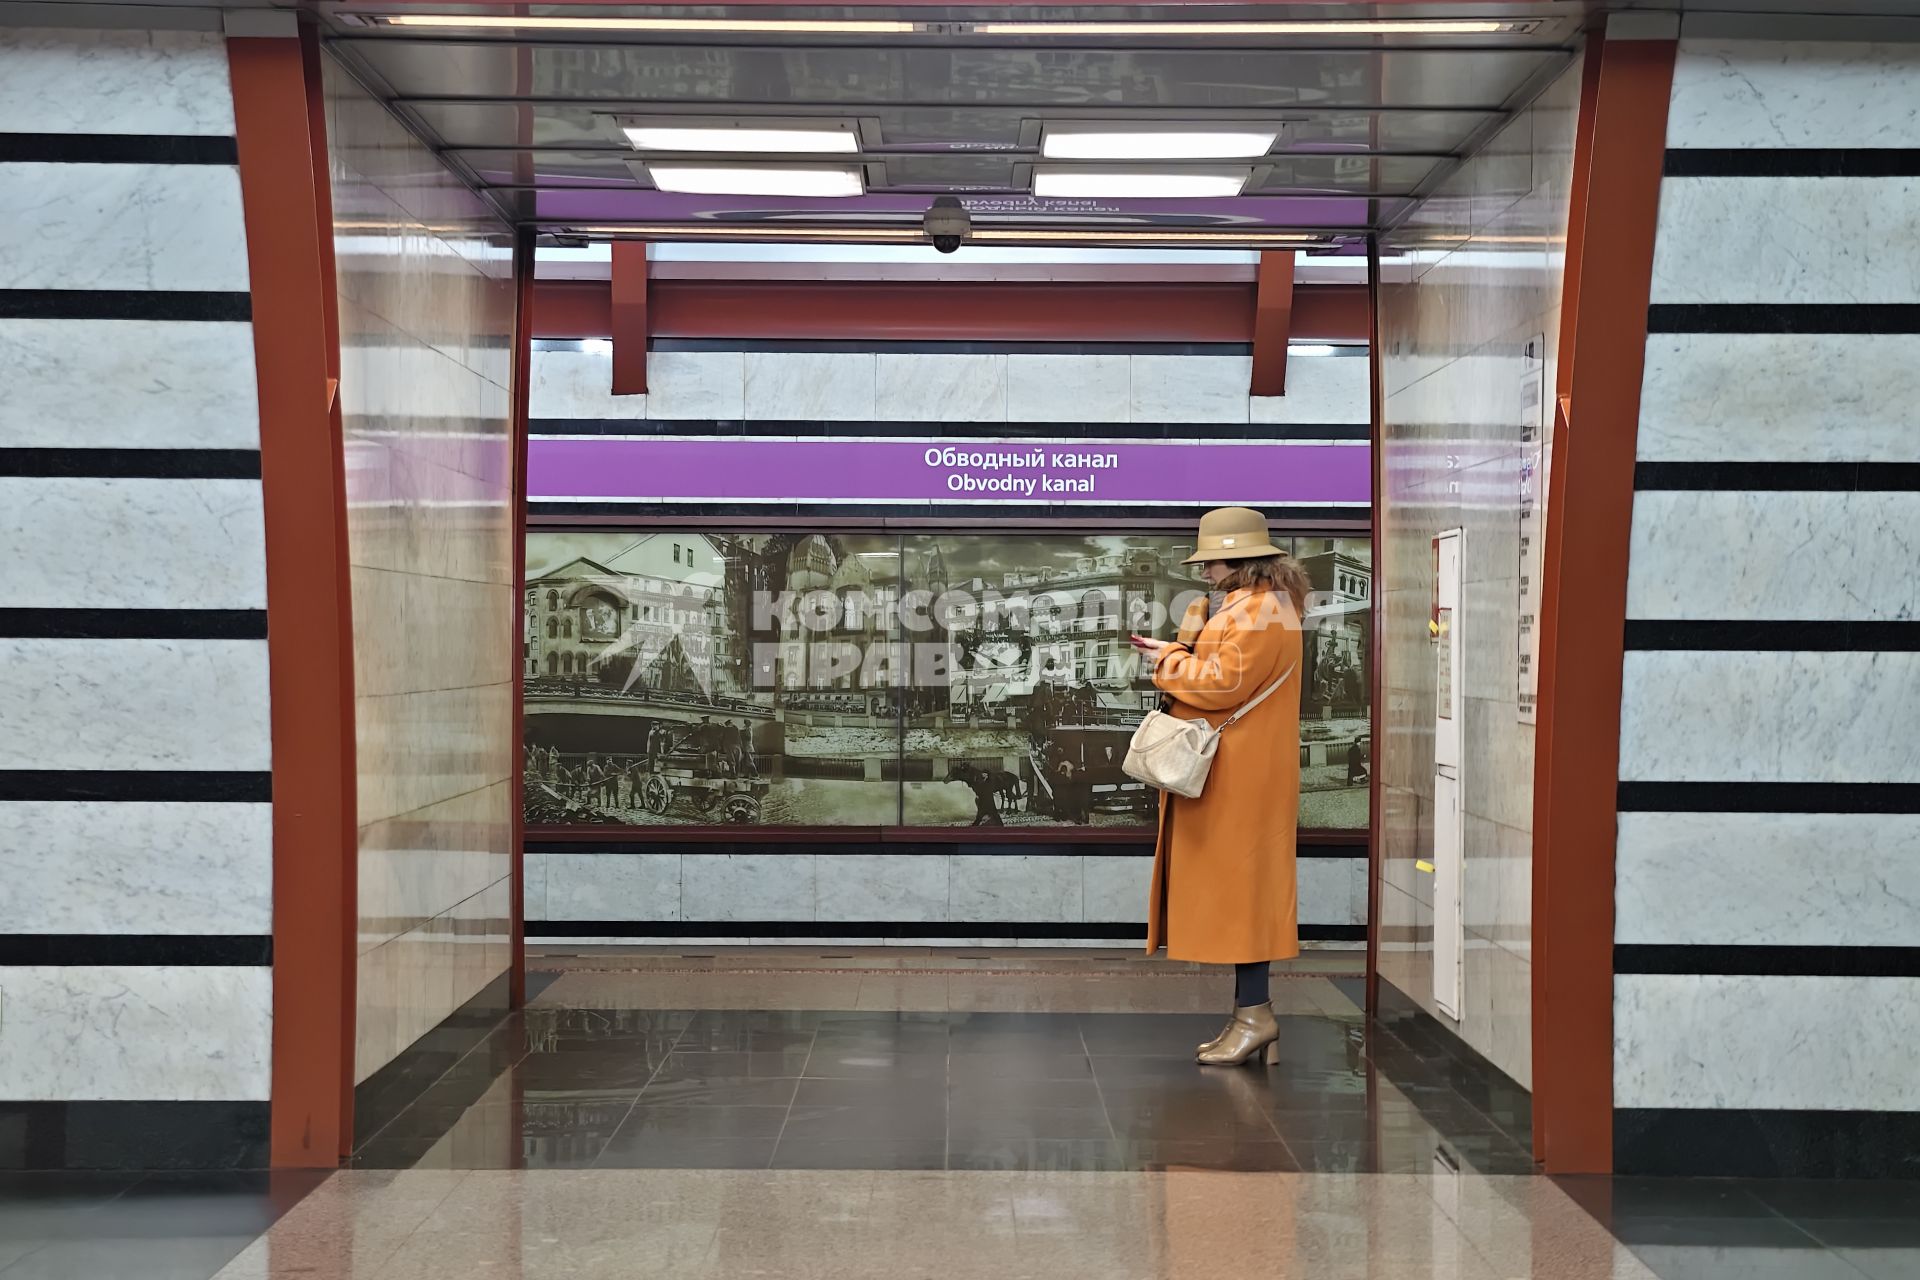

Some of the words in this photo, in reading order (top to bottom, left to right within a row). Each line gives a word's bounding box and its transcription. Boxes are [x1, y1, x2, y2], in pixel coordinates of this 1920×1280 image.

[924, 447, 1045, 470] Обводный
[1052, 454, 1118, 468] канал
[947, 474, 1036, 496] Obvodny
[1042, 475, 1095, 492] kanal
